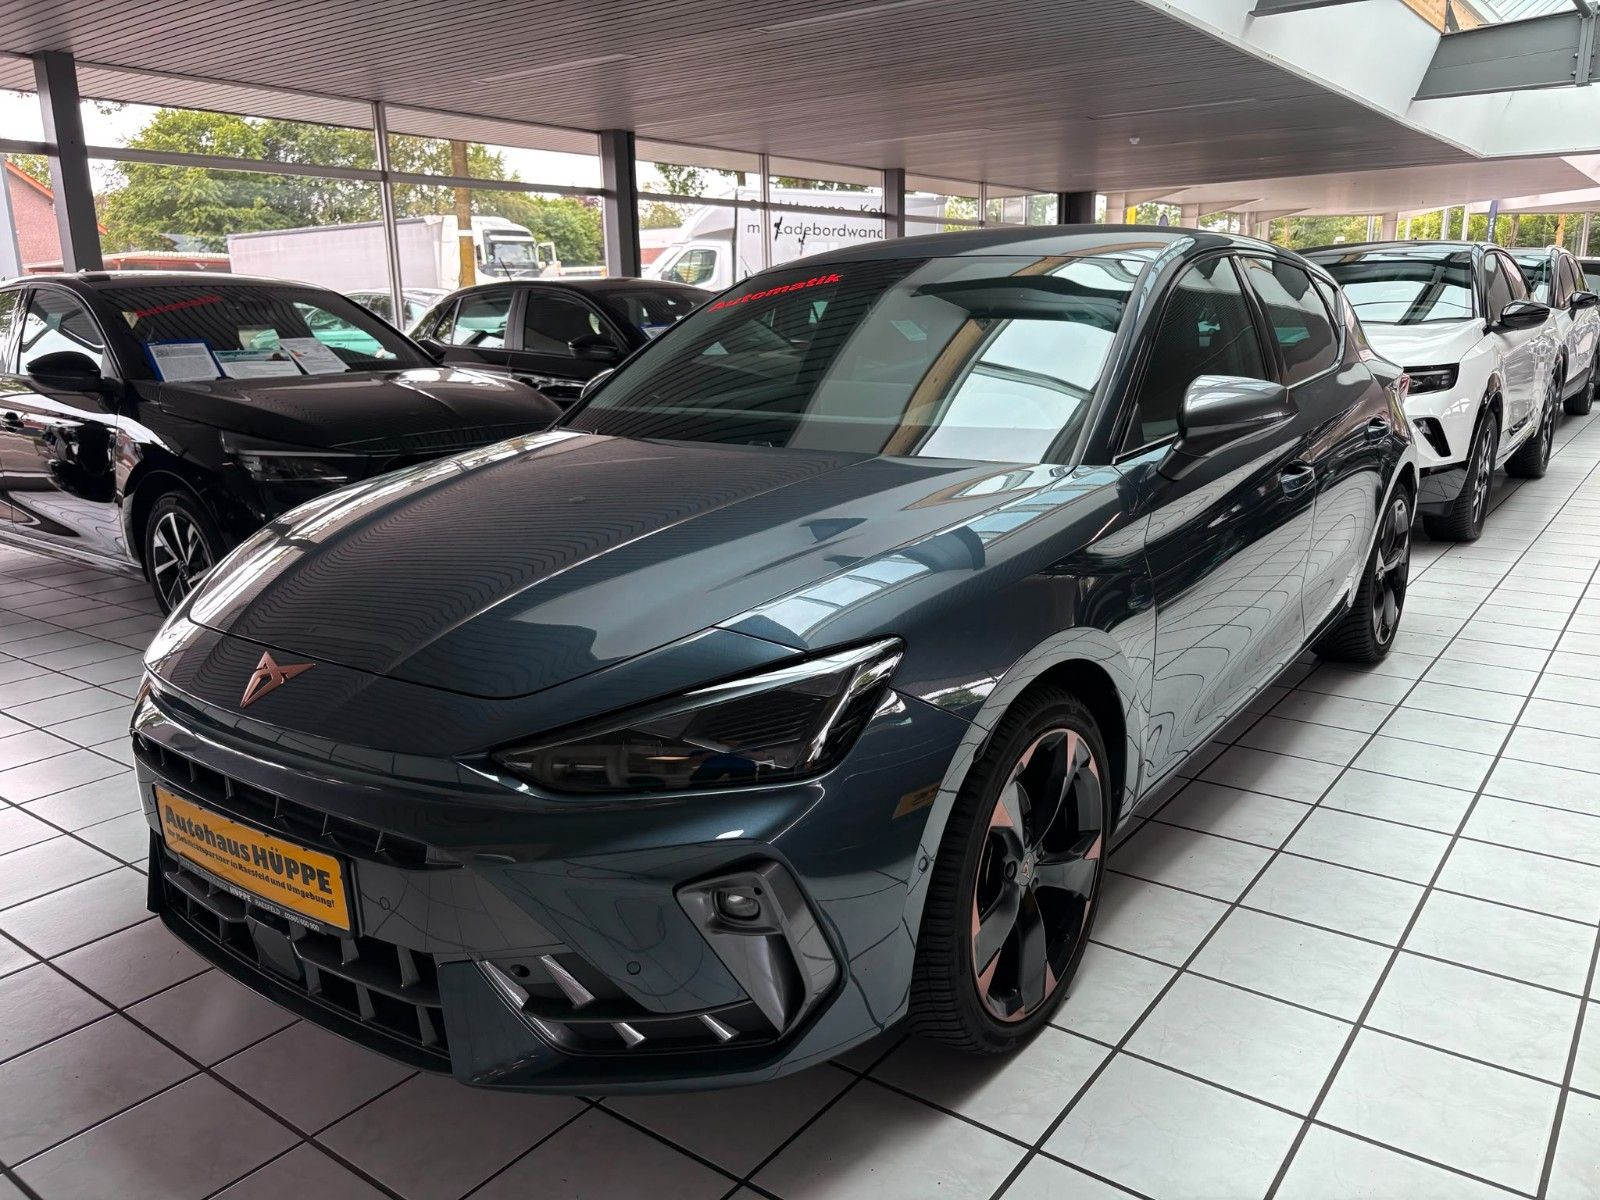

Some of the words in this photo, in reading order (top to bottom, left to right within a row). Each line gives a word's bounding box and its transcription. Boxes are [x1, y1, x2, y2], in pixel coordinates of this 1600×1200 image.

[707, 273, 843, 313] Automatik
[165, 804, 250, 862] Autohaus
[251, 843, 333, 894] HÜPPE
[270, 877, 286, 889] und
[286, 882, 335, 908] Umgebung!
